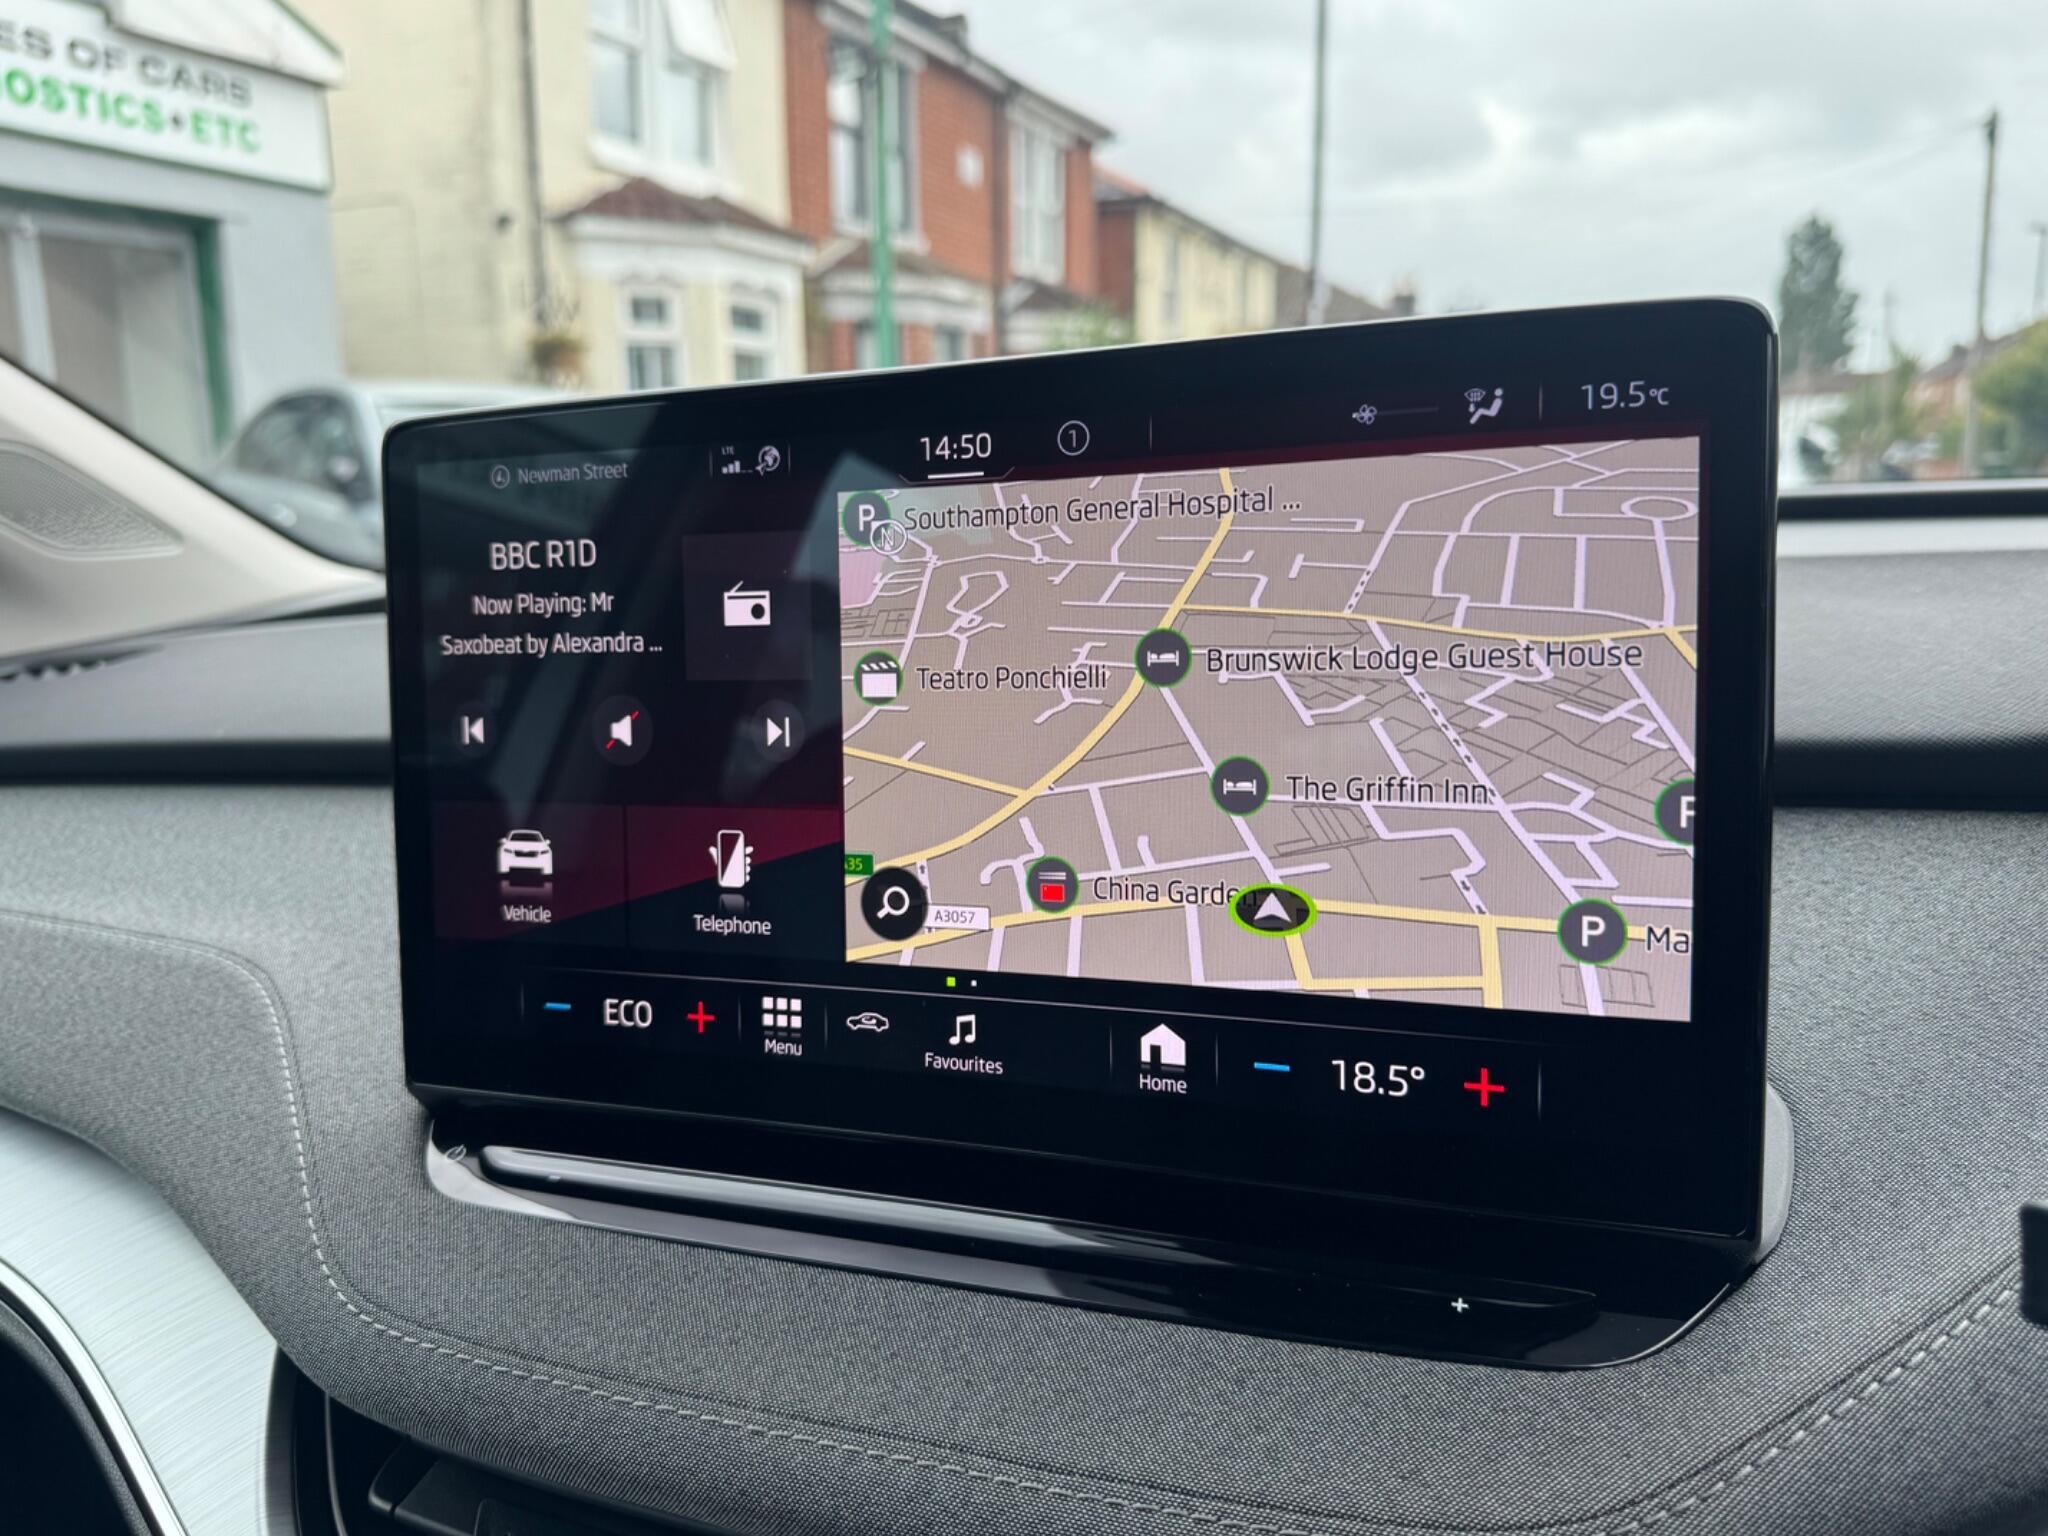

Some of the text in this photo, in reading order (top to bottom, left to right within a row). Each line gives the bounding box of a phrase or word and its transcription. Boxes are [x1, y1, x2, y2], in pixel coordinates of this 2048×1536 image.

[67, 38, 127, 72] OF
[721, 446, 734, 456] LTE
[919, 432, 993, 462] 14:50
[518, 462, 629, 484] Newman Street
[904, 502, 1059, 531] Southampton
[1066, 490, 1159, 522] General
[1168, 485, 1274, 520] Hospital
[490, 537, 598, 571] BBC R1D
[472, 591, 615, 619] Now Playing: Mr
[441, 634, 523, 656] Saxobeat
[526, 632, 548, 659] by
[552, 630, 645, 654] Alexandra
[1207, 640, 1643, 676] Brunswick Lodge Guest House
[916, 664, 1108, 692] Teatro Ponchielli
[1287, 774, 1489, 805] The Griffin Inn
[1093, 876, 1160, 903] China
[503, 904, 552, 924] Vehicle
[693, 914, 772, 937] Telephone
[934, 909, 976, 926] A3057
[1580, 916, 1606, 949] P
[603, 998, 654, 1029] ECO
[764, 1038, 803, 1057] Menu
[925, 1051, 1004, 1075] Favourites
[1139, 1073, 1188, 1095] Home
